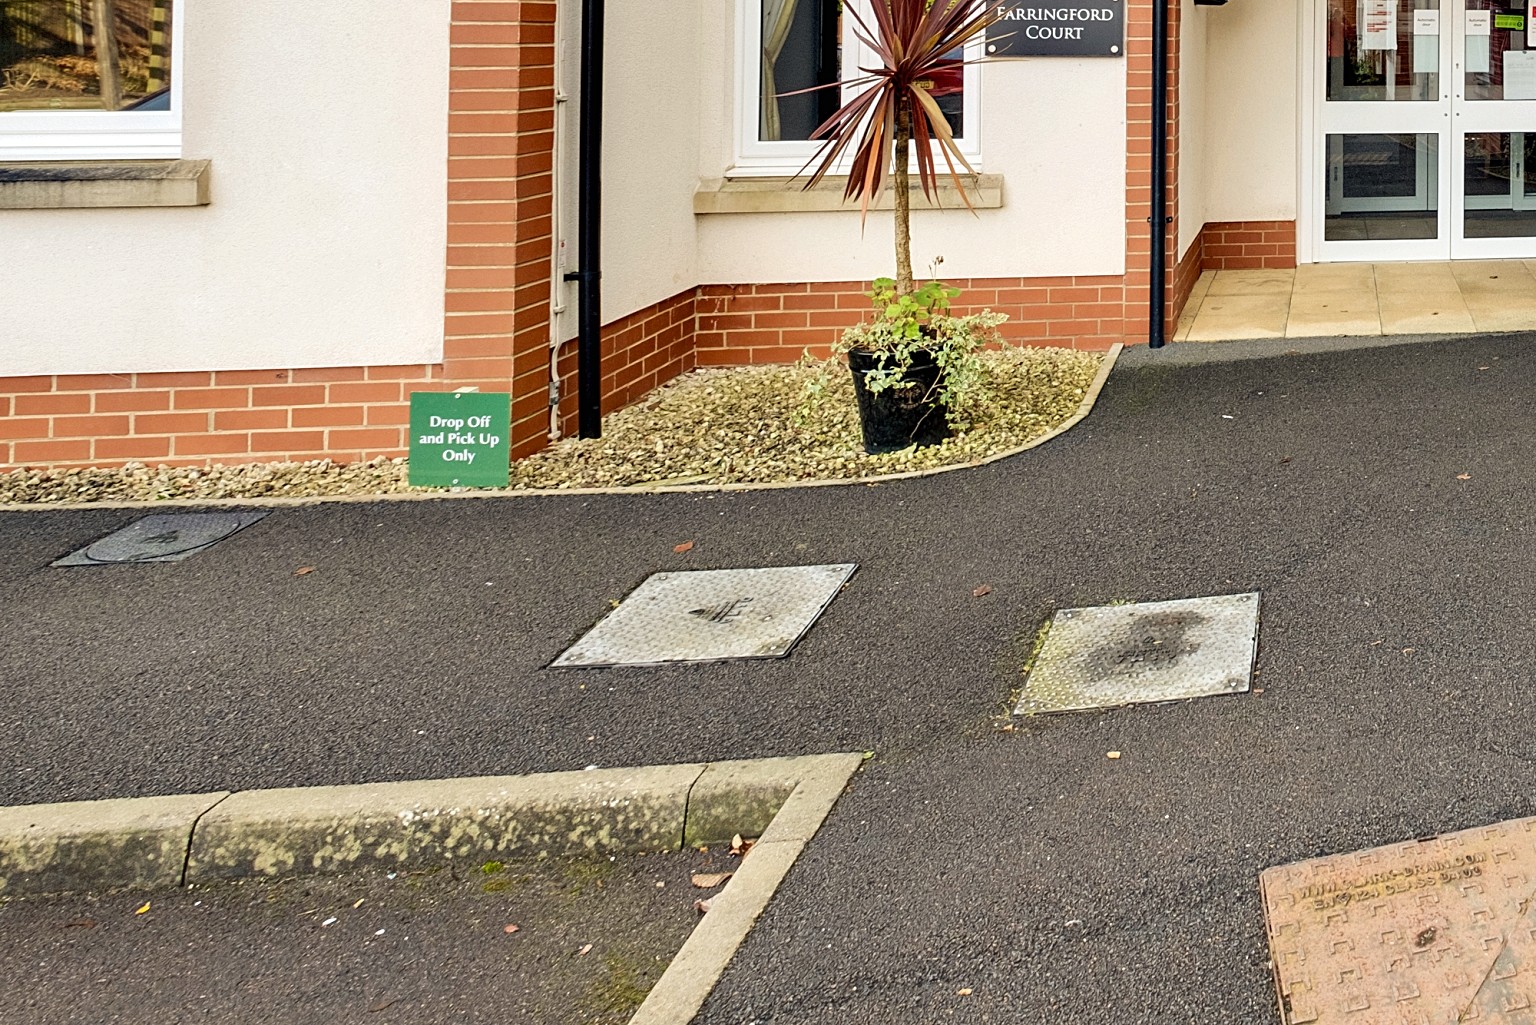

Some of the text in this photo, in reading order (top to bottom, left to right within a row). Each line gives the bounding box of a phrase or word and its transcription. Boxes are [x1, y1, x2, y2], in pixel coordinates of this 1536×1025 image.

[996, 6, 1114, 22] FARRINGFORD
[1025, 25, 1085, 40] COURT
[429, 415, 492, 431] Drop Off
[419, 431, 500, 449] and Pick Up
[442, 449, 476, 465] Only
[1385, 875, 1437, 896] CLASS
